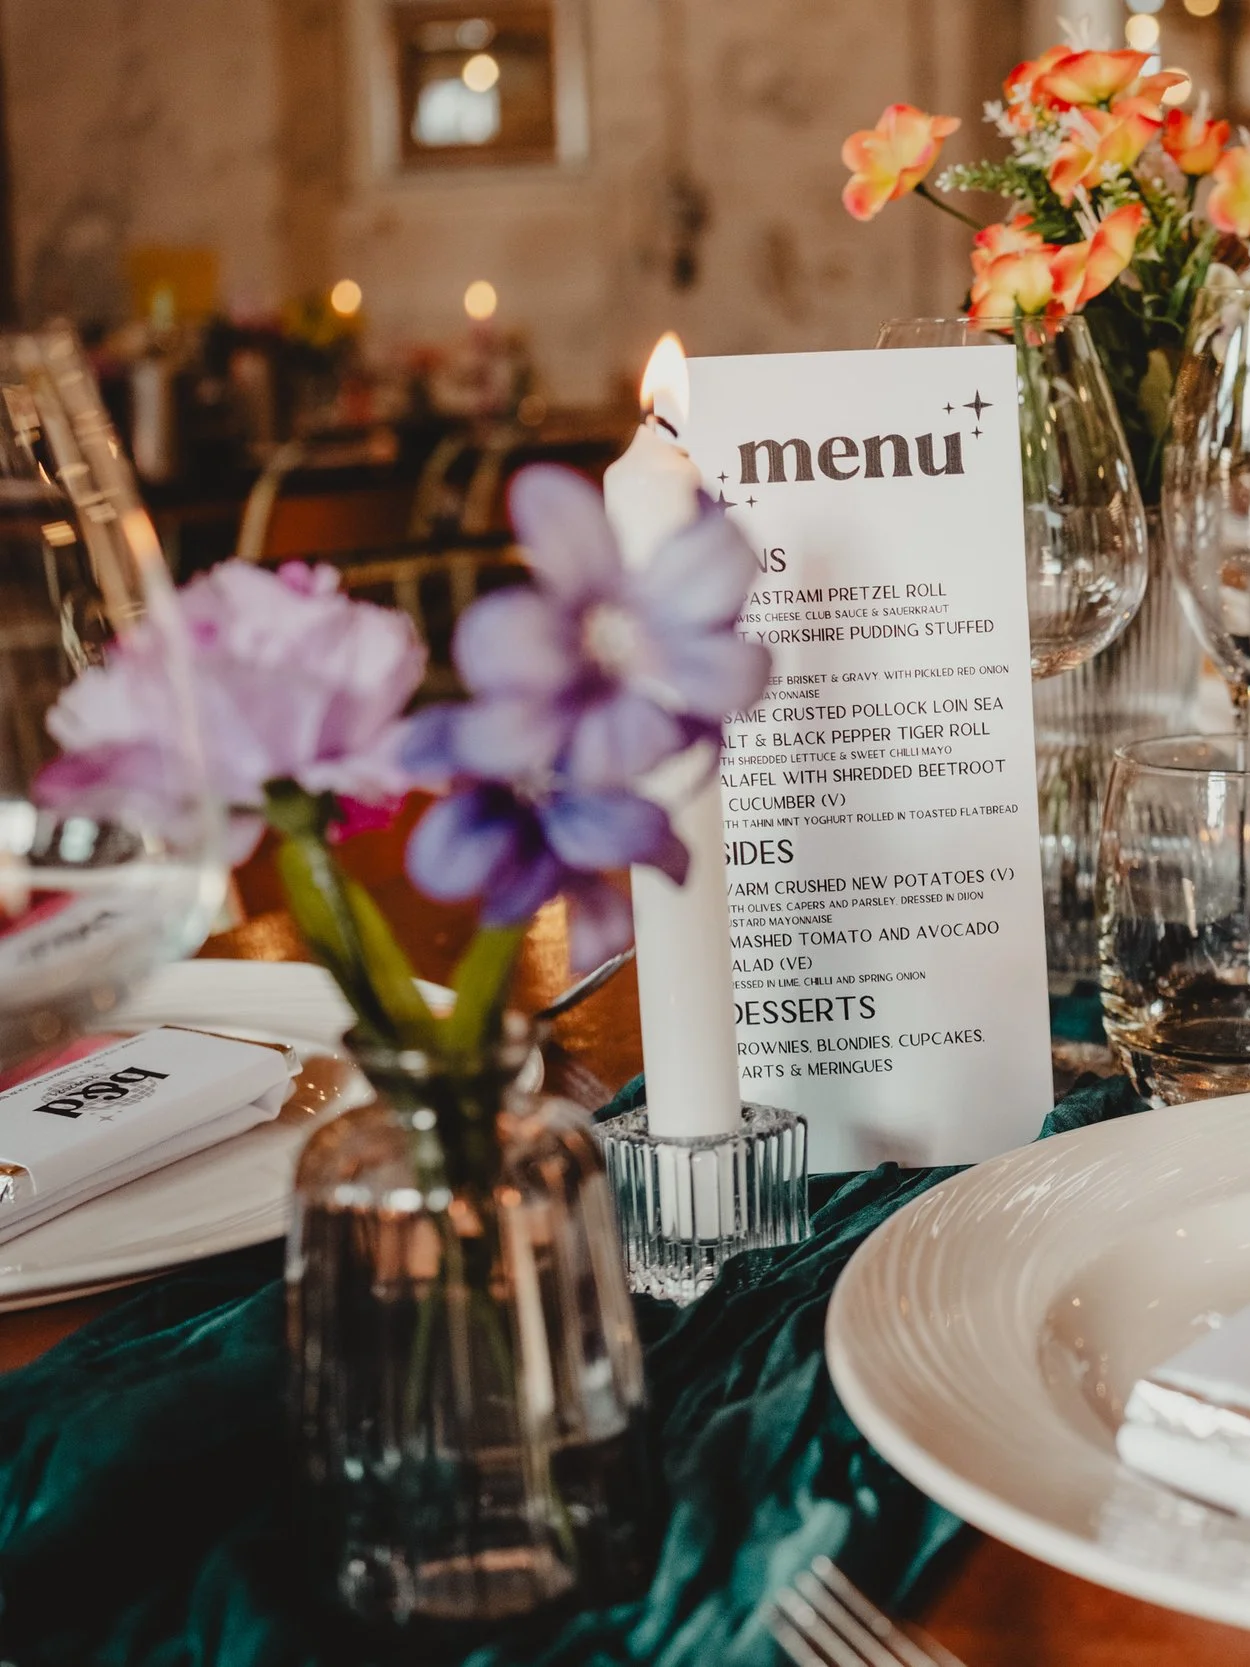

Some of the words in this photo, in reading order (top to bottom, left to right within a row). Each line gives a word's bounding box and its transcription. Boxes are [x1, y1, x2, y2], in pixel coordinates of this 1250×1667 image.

[737, 430, 965, 484] menu
[743, 588, 823, 606] ASTRAMI
[828, 584, 901, 602] PRETZEL
[906, 582, 947, 598] ROLL
[736, 613, 761, 623] WISS
[805, 610, 832, 621] CLUB
[835, 608, 868, 619] SAUCE
[871, 607, 879, 617] &
[883, 604, 949, 617] SAUERKRAUT
[757, 627, 845, 645] YORKSHIRE
[850, 622, 919, 640] PUDDING
[925, 619, 994, 636] STUFFED
[767, 676, 783, 686] EEF
[787, 674, 827, 685] BRISKET
[831, 673, 839, 683] &
[884, 670, 912, 680] WITH
[914, 667, 954, 679] PICKLED
[957, 666, 976, 676] RED
[979, 664, 1010, 675] ONION
[761, 689, 820, 701] AYONNAISE
[723, 709, 766, 725] SAME
[772, 705, 847, 722] CRUSTED
[852, 700, 928, 718] POLLOCK
[933, 698, 968, 714] LOIN
[974, 697, 1004, 711] SEA
[720, 734, 748, 749] ALT
[755, 733, 767, 747] &
[773, 730, 826, 747] BLACK
[831, 727, 891, 744] PEPPER
[897, 723, 944, 740] TIGER
[949, 721, 990, 737] ROLL
[720, 756, 735, 766] TH
[738, 754, 788, 766] SHREDDED
[790, 751, 836, 764] LETTUCE
[839, 751, 847, 761] &
[851, 749, 886, 760] SWEET
[889, 747, 919, 758] CHILLI
[921, 745, 952, 756] MAYO
[720, 771, 776, 788] ALAFEL
[783, 769, 827, 785] WITH
[832, 765, 912, 783] SHREDDED
[918, 759, 1006, 778] BEETROOT
[728, 794, 815, 812] CUCUMBER
[821, 792, 846, 807] (V)
[723, 819, 739, 830] TH
[742, 818, 774, 829] TAHINI
[777, 816, 800, 827] MINT
[804, 813, 853, 826] YOGHURT
[856, 811, 894, 823] ROLLED
[897, 811, 906, 821] IN
[909, 807, 957, 820] TOASTED
[960, 804, 1019, 817] FLATBREAD
[727, 881, 769, 897] ARM
[775, 877, 847, 895] CRUSHED
[852, 875, 888, 891] NEW
[894, 869, 985, 889] POTATOES
[990, 867, 1015, 882] (V)
[728, 904, 744, 914] TH
[786, 900, 826, 911] CAPERS
[829, 898, 849, 909] AND
[901, 893, 943, 905] DRESSED
[946, 893, 955, 902] IN
[730, 917, 766, 929] STARD
[769, 914, 833, 926] MAYONNAISE
[730, 933, 792, 949] MASHED
[798, 928, 872, 946] TOMATO
[879, 926, 910, 942] AND
[916, 920, 999, 939] AVOCADO
[732, 957, 774, 973] ALAD
[780, 956, 813, 971] (VE)
[733, 979, 764, 990] ESSED
[767, 979, 775, 988] IN
[836, 975, 855, 985] AND
[859, 972, 893, 984] SPRING
[896, 971, 926, 982] ONION
[737, 1039, 812, 1056] ROWNIES,
[739, 1064, 784, 1079] ARTS
[791, 1063, 802, 1077] &
[808, 1058, 893, 1076] MERINGUES
